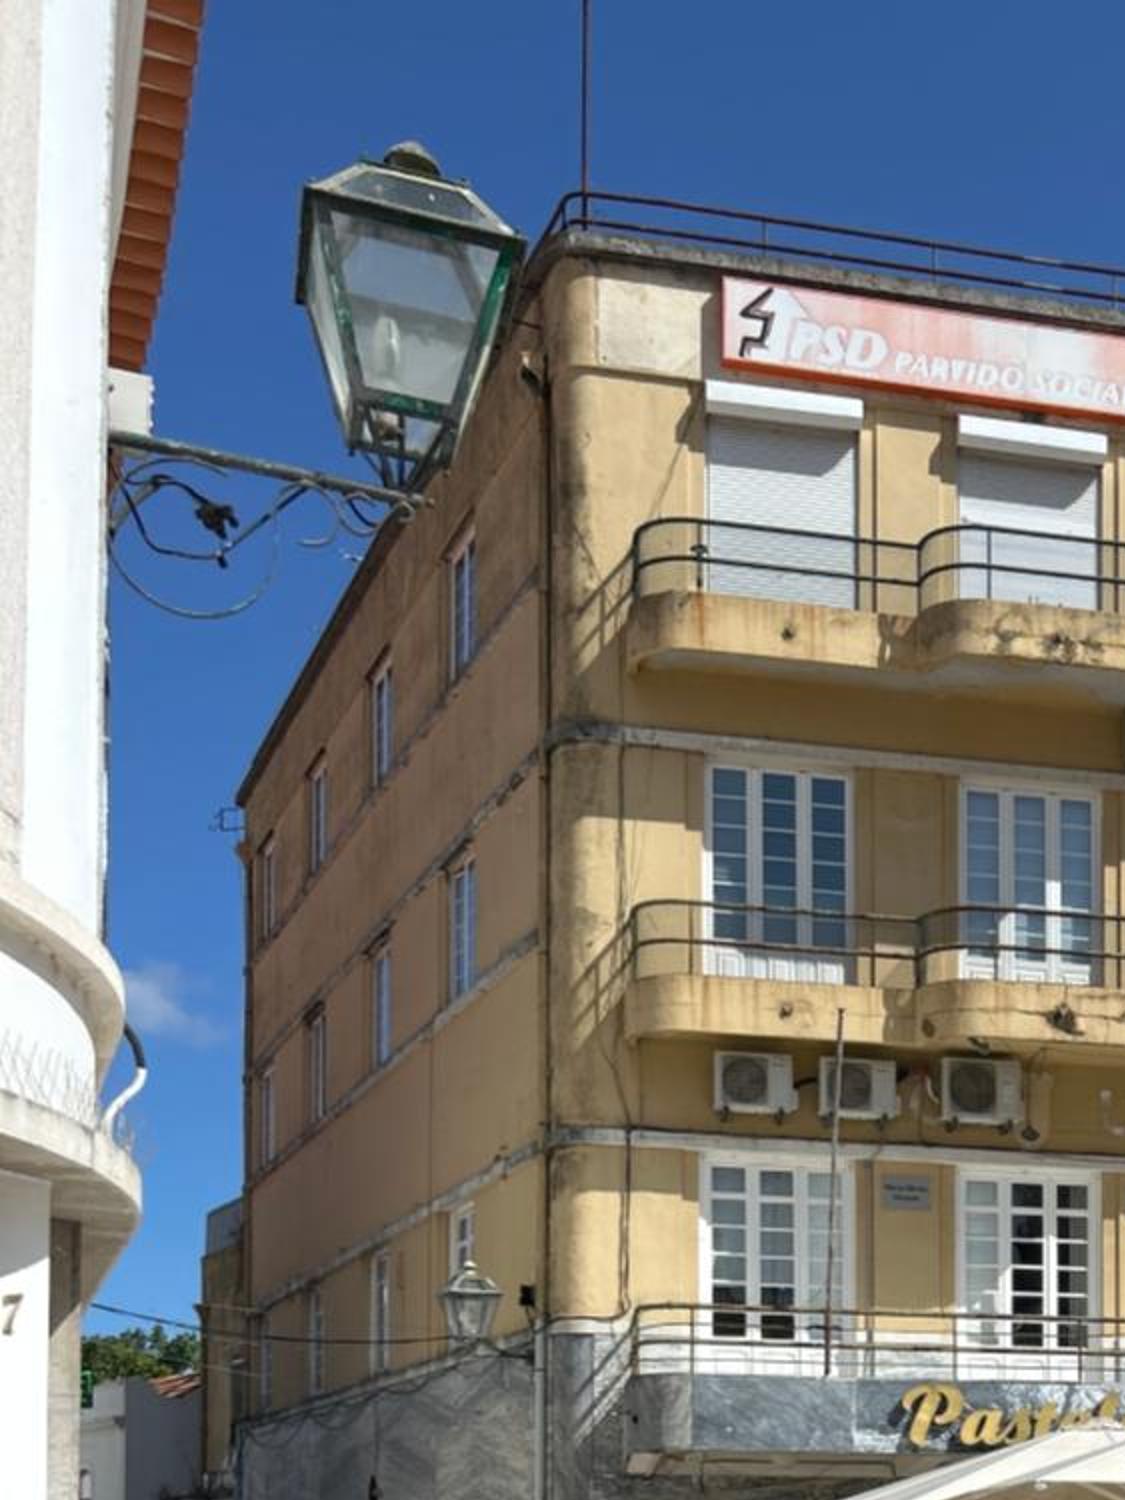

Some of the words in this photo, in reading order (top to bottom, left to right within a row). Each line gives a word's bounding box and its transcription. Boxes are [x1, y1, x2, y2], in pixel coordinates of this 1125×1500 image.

[790, 319, 888, 369] PSD
[895, 350, 1025, 391] PARTIDO
[2, 1291, 25, 1337] 7
